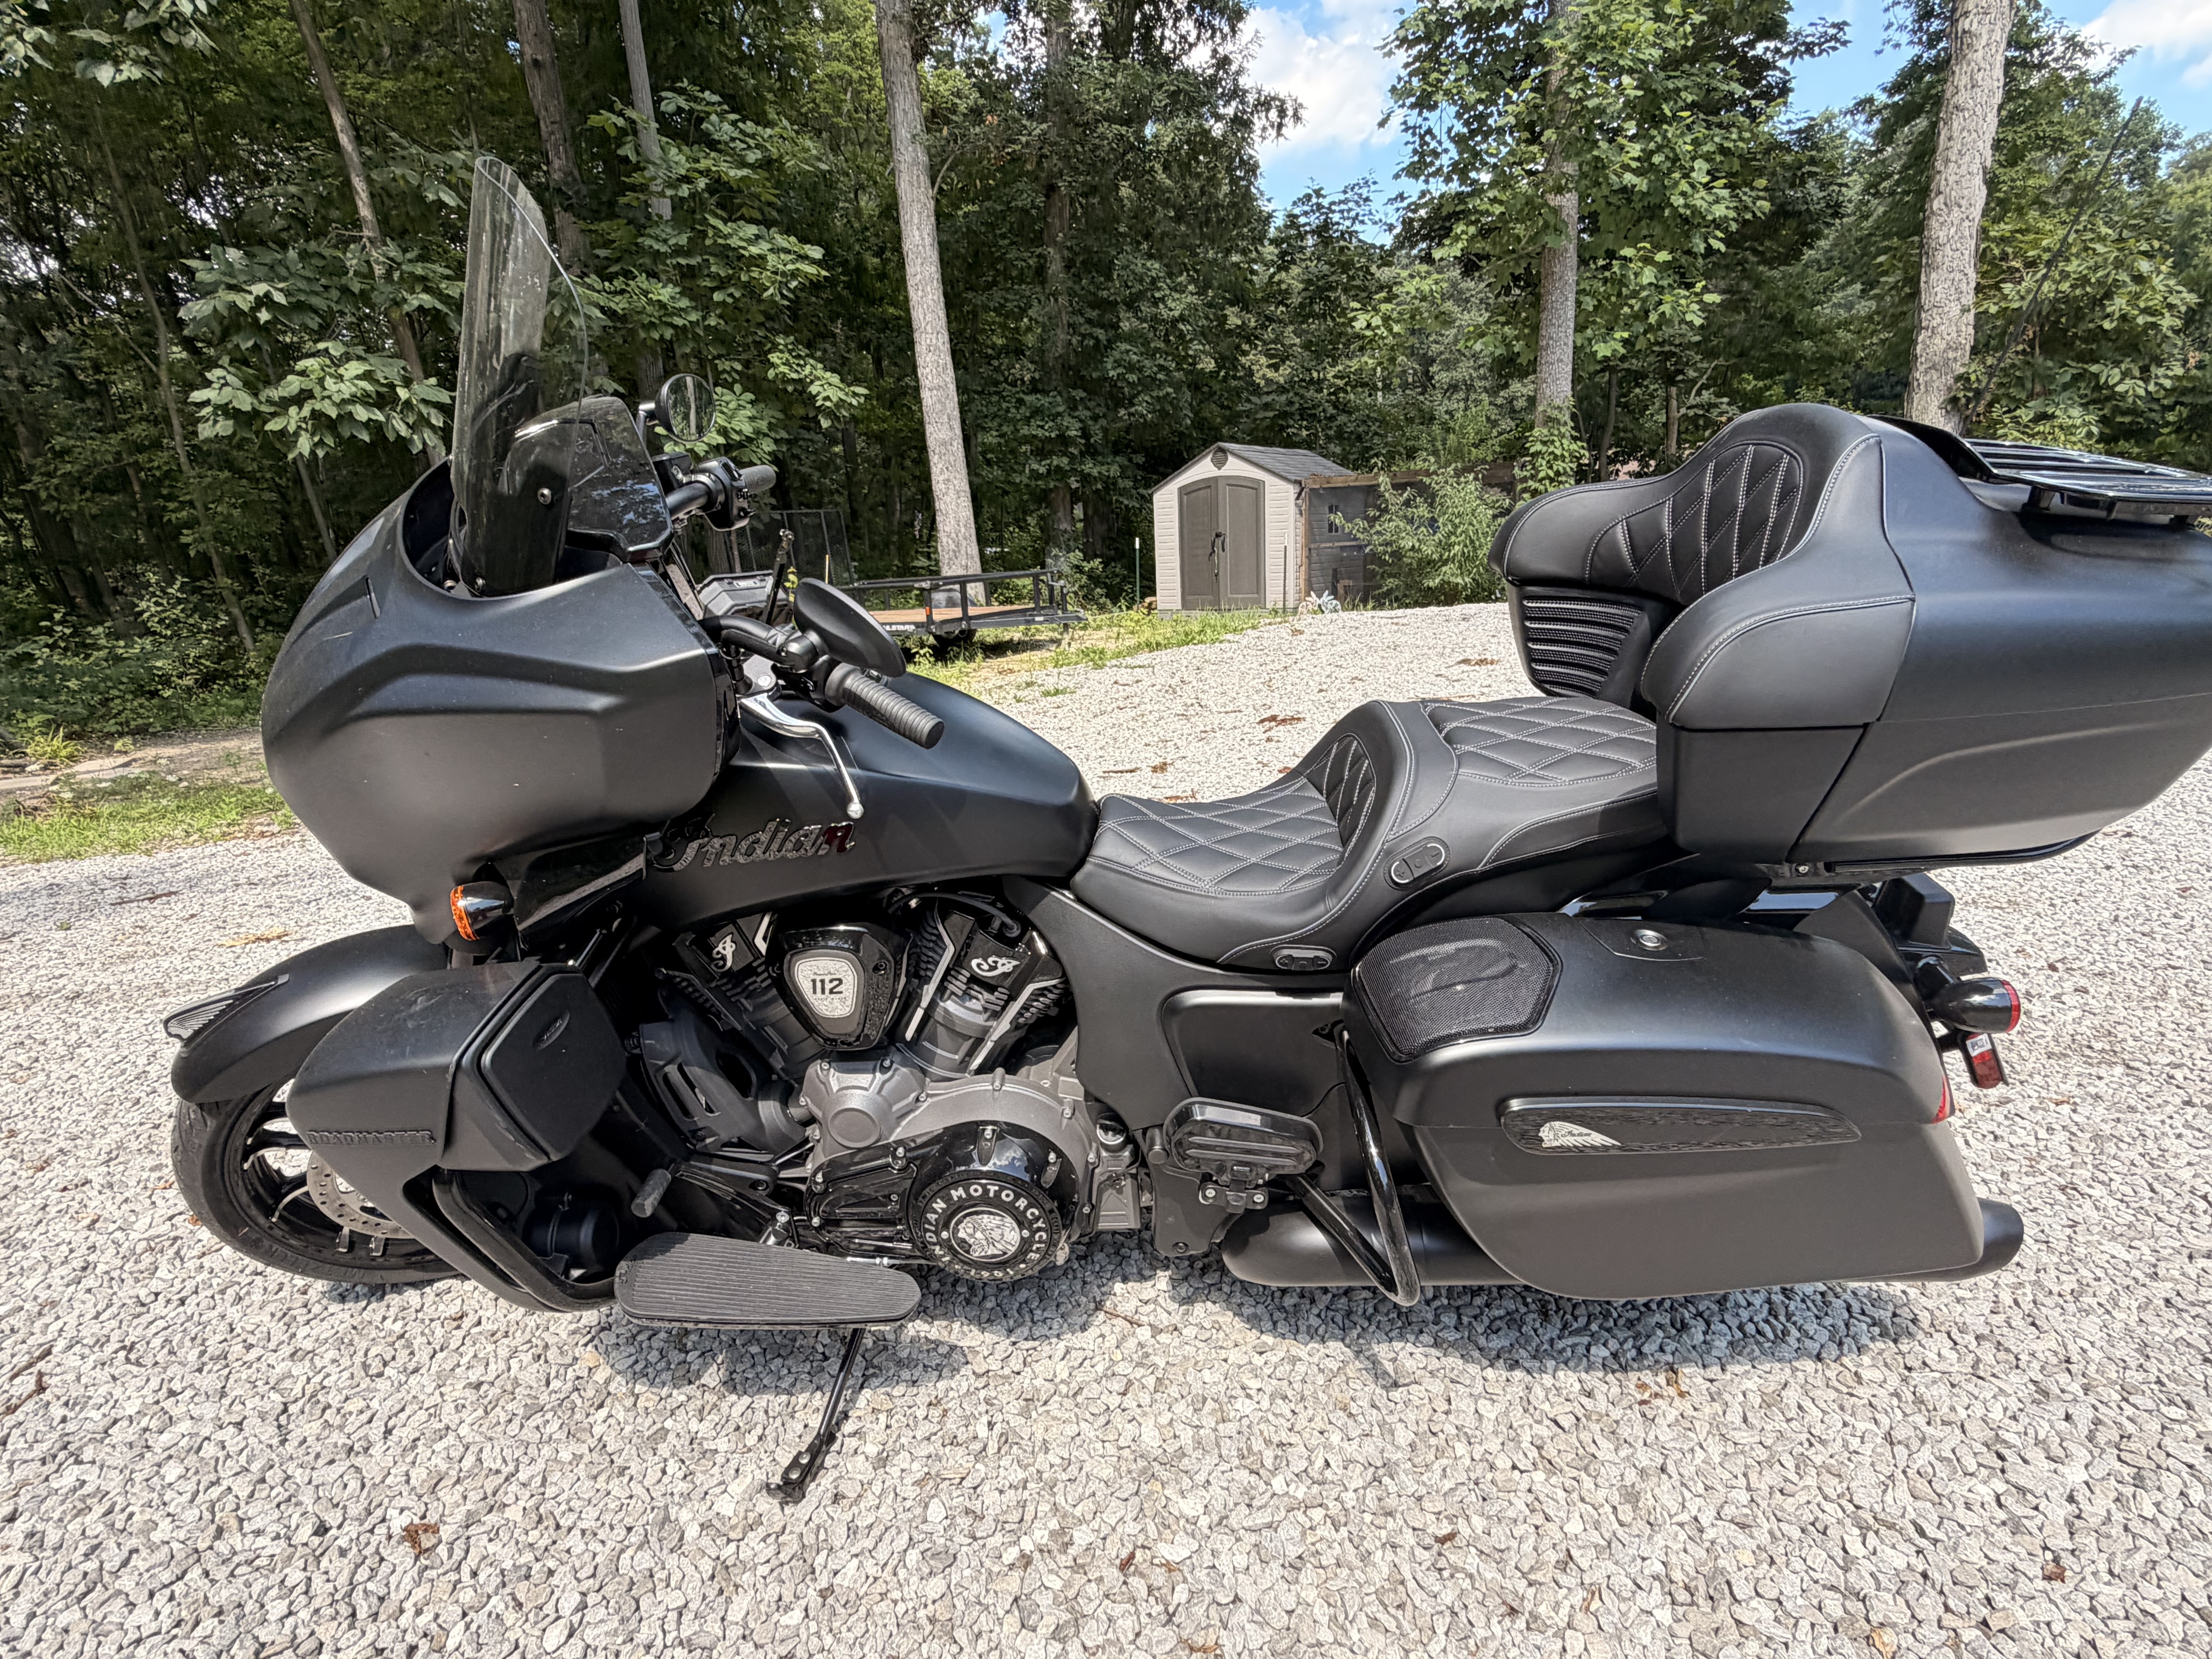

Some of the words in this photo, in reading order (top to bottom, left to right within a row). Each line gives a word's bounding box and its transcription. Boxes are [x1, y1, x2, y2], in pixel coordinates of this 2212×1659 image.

[652, 812, 855, 872] Indian
[811, 978, 843, 995] 112
[306, 1130, 436, 1144] ROADMASTER
[924, 1198, 951, 1262] INDIAN
[950, 1184, 1047, 1261] MOTORCYCLE
